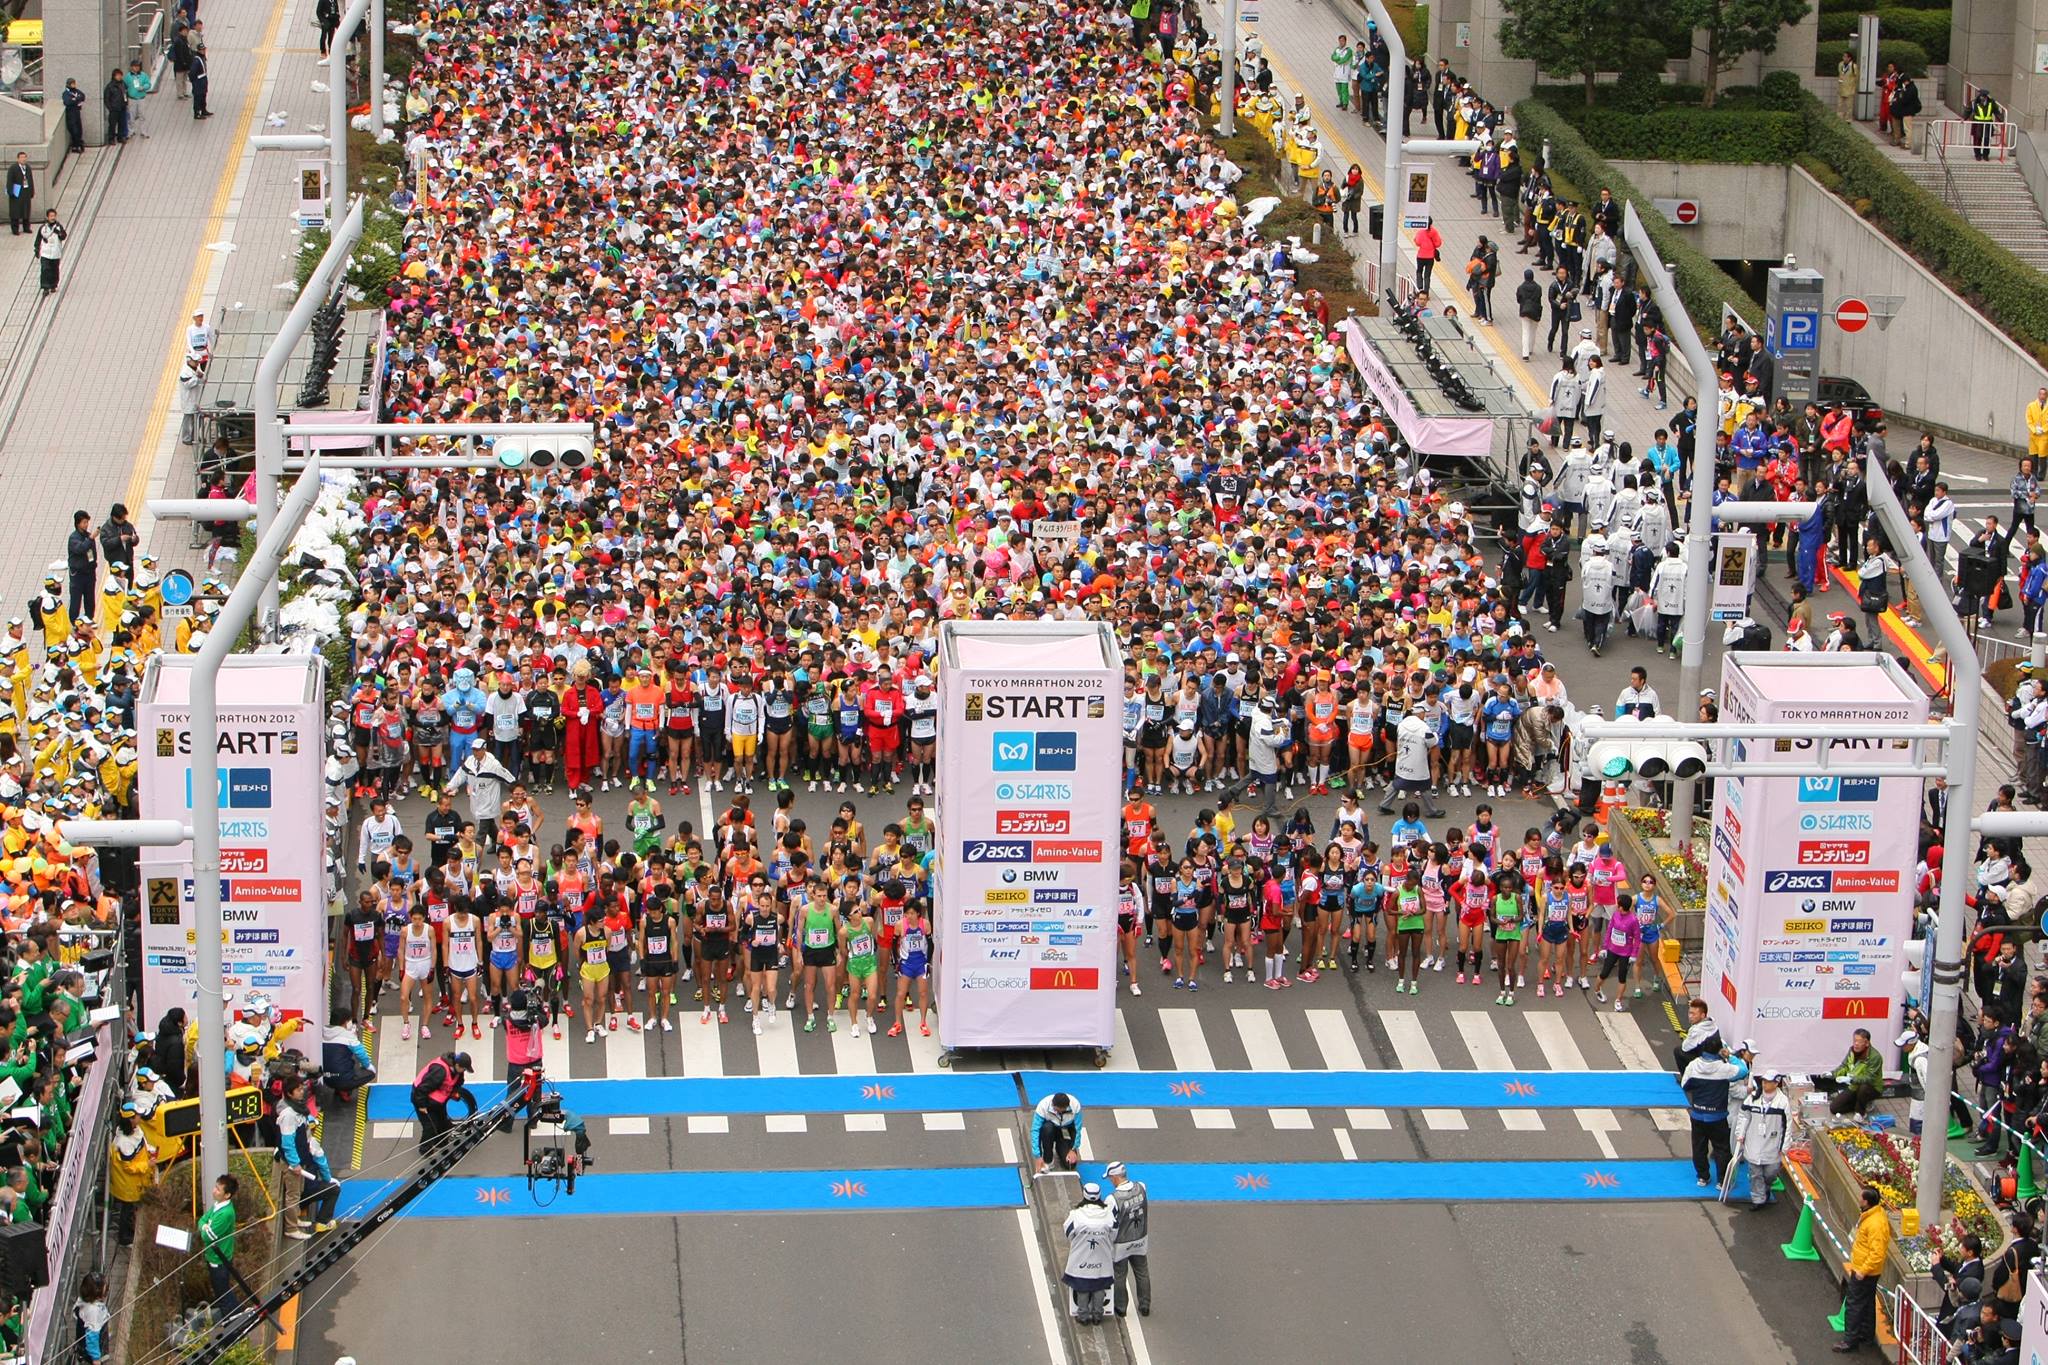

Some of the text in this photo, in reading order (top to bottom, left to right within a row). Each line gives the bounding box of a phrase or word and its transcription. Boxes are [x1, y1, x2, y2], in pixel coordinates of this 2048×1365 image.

[1786, 316, 1811, 346] P
[970, 679, 1103, 687] TOKYO MARATHON 2012
[986, 695, 1085, 718] START
[161, 714, 191, 723] TOKY
[269, 714, 295, 723] 2012
[1781, 710, 1909, 720] TOKYO MARATHON 2012
[178, 731, 278, 754] SART
[233, 784, 268, 792] 東京メトロ
[1001, 819, 1067, 832] ランチパック
[986, 844, 1024, 858] asics
[1036, 847, 1099, 856] Amino-Value
[1802, 849, 1866, 863] ランチパック
[1023, 871, 1059, 881] BMW
[1787, 875, 1825, 888] asics
[1835, 877, 1896, 887] Amino-Value
[234, 886, 299, 896] Amino-Value
[986, 892, 1026, 901] SEIKO
[1035, 892, 1077, 901] みずほ銀行
[1822, 901, 1856, 911] BMW
[223, 910, 258, 921] BMW
[436, 909, 442, 918] 2
[1063, 909, 1083, 917] ANA
[1785, 922, 1824, 931] SEIKO
[1832, 921, 1873, 930] みずほ銀行
[235, 932, 277, 940] みずほ銀行
[363, 928, 368, 937] 7
[763, 935, 768, 943] 6
[816, 934, 821, 943] 8
[1020, 935, 1040, 944] Dole
[1858, 938, 1877, 946] ANA
[457, 943, 468, 951] 16
[500, 939, 511, 948] 15
[265, 949, 285, 957] ANA
[535, 944, 547, 953] 57
[1815, 965, 1835, 974] Dole
[222, 977, 242, 986] Dole
